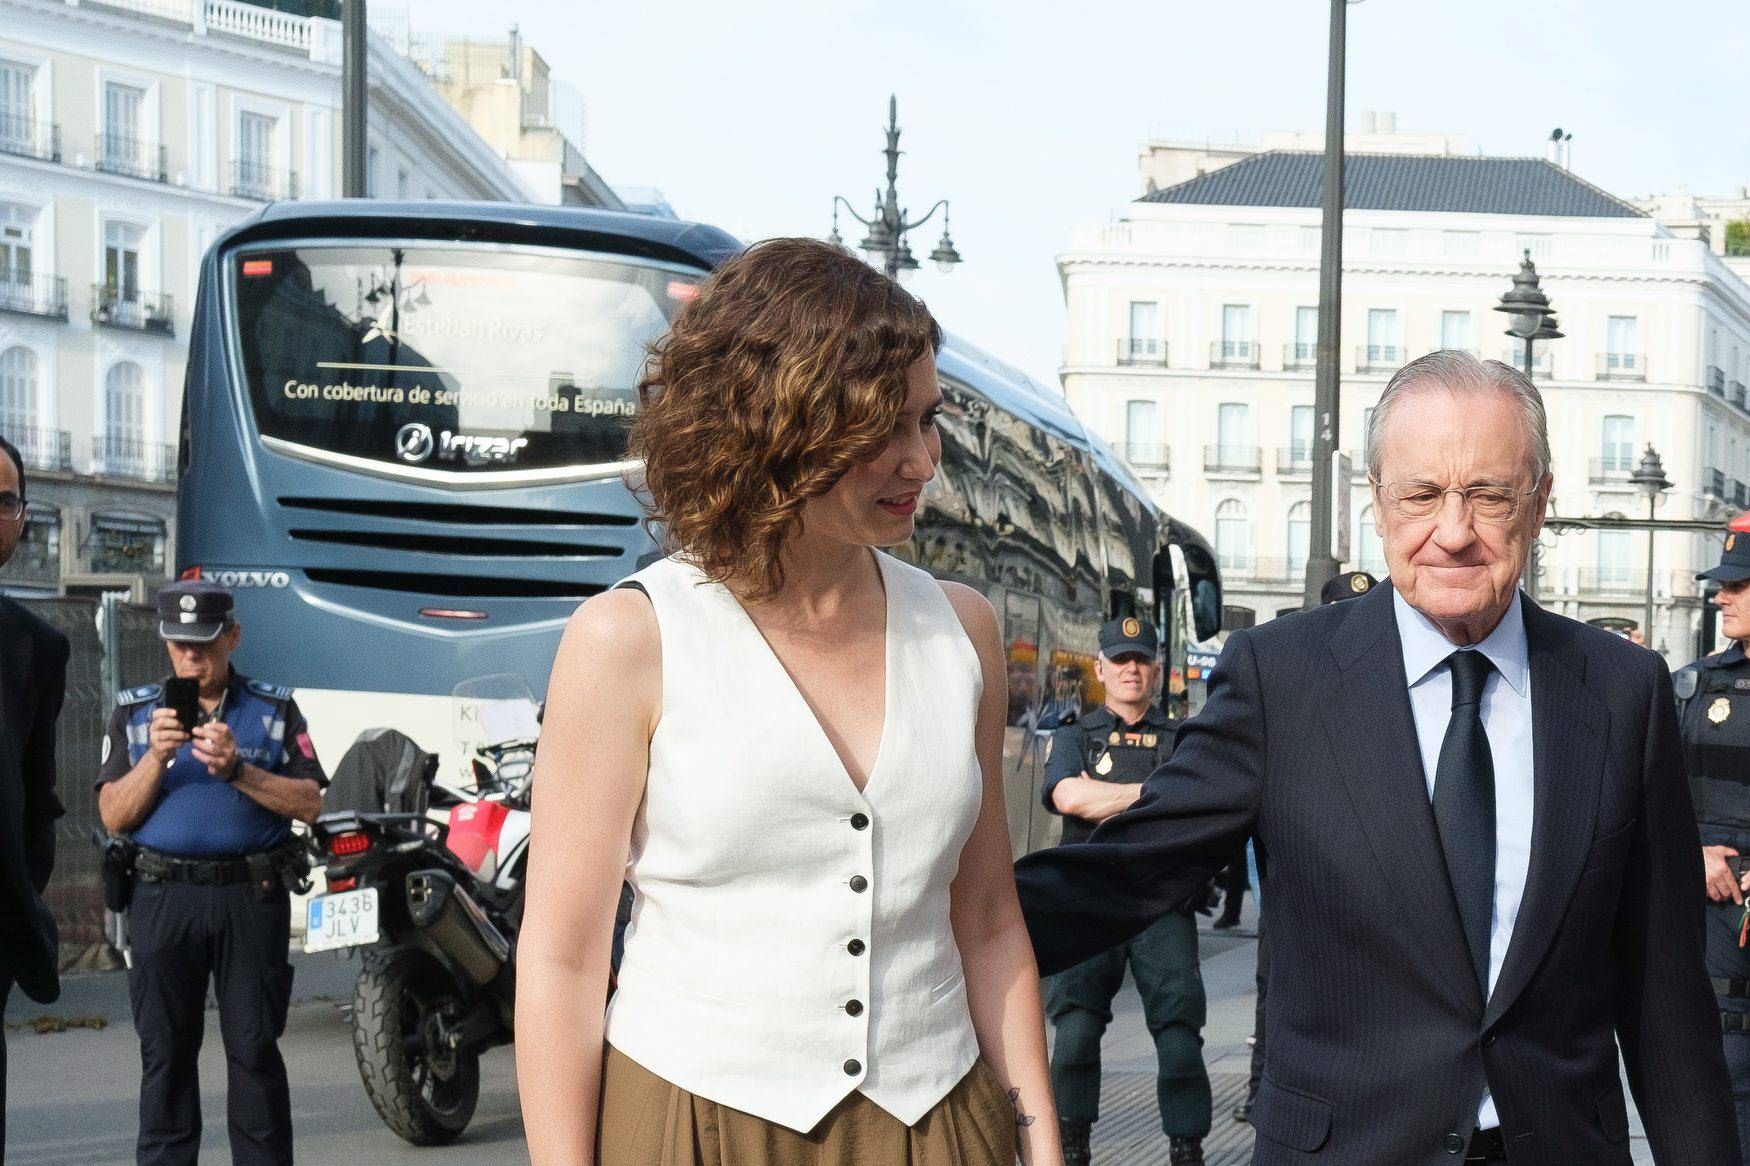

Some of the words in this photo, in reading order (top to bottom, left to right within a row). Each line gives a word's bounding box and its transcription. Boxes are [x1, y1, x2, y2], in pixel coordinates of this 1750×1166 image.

[284, 380, 319, 399] Con
[322, 381, 404, 403] cobertura
[408, 384, 431, 404] de
[574, 394, 636, 418] España
[201, 571, 290, 588] VOLVO
[326, 893, 373, 918] 3436
